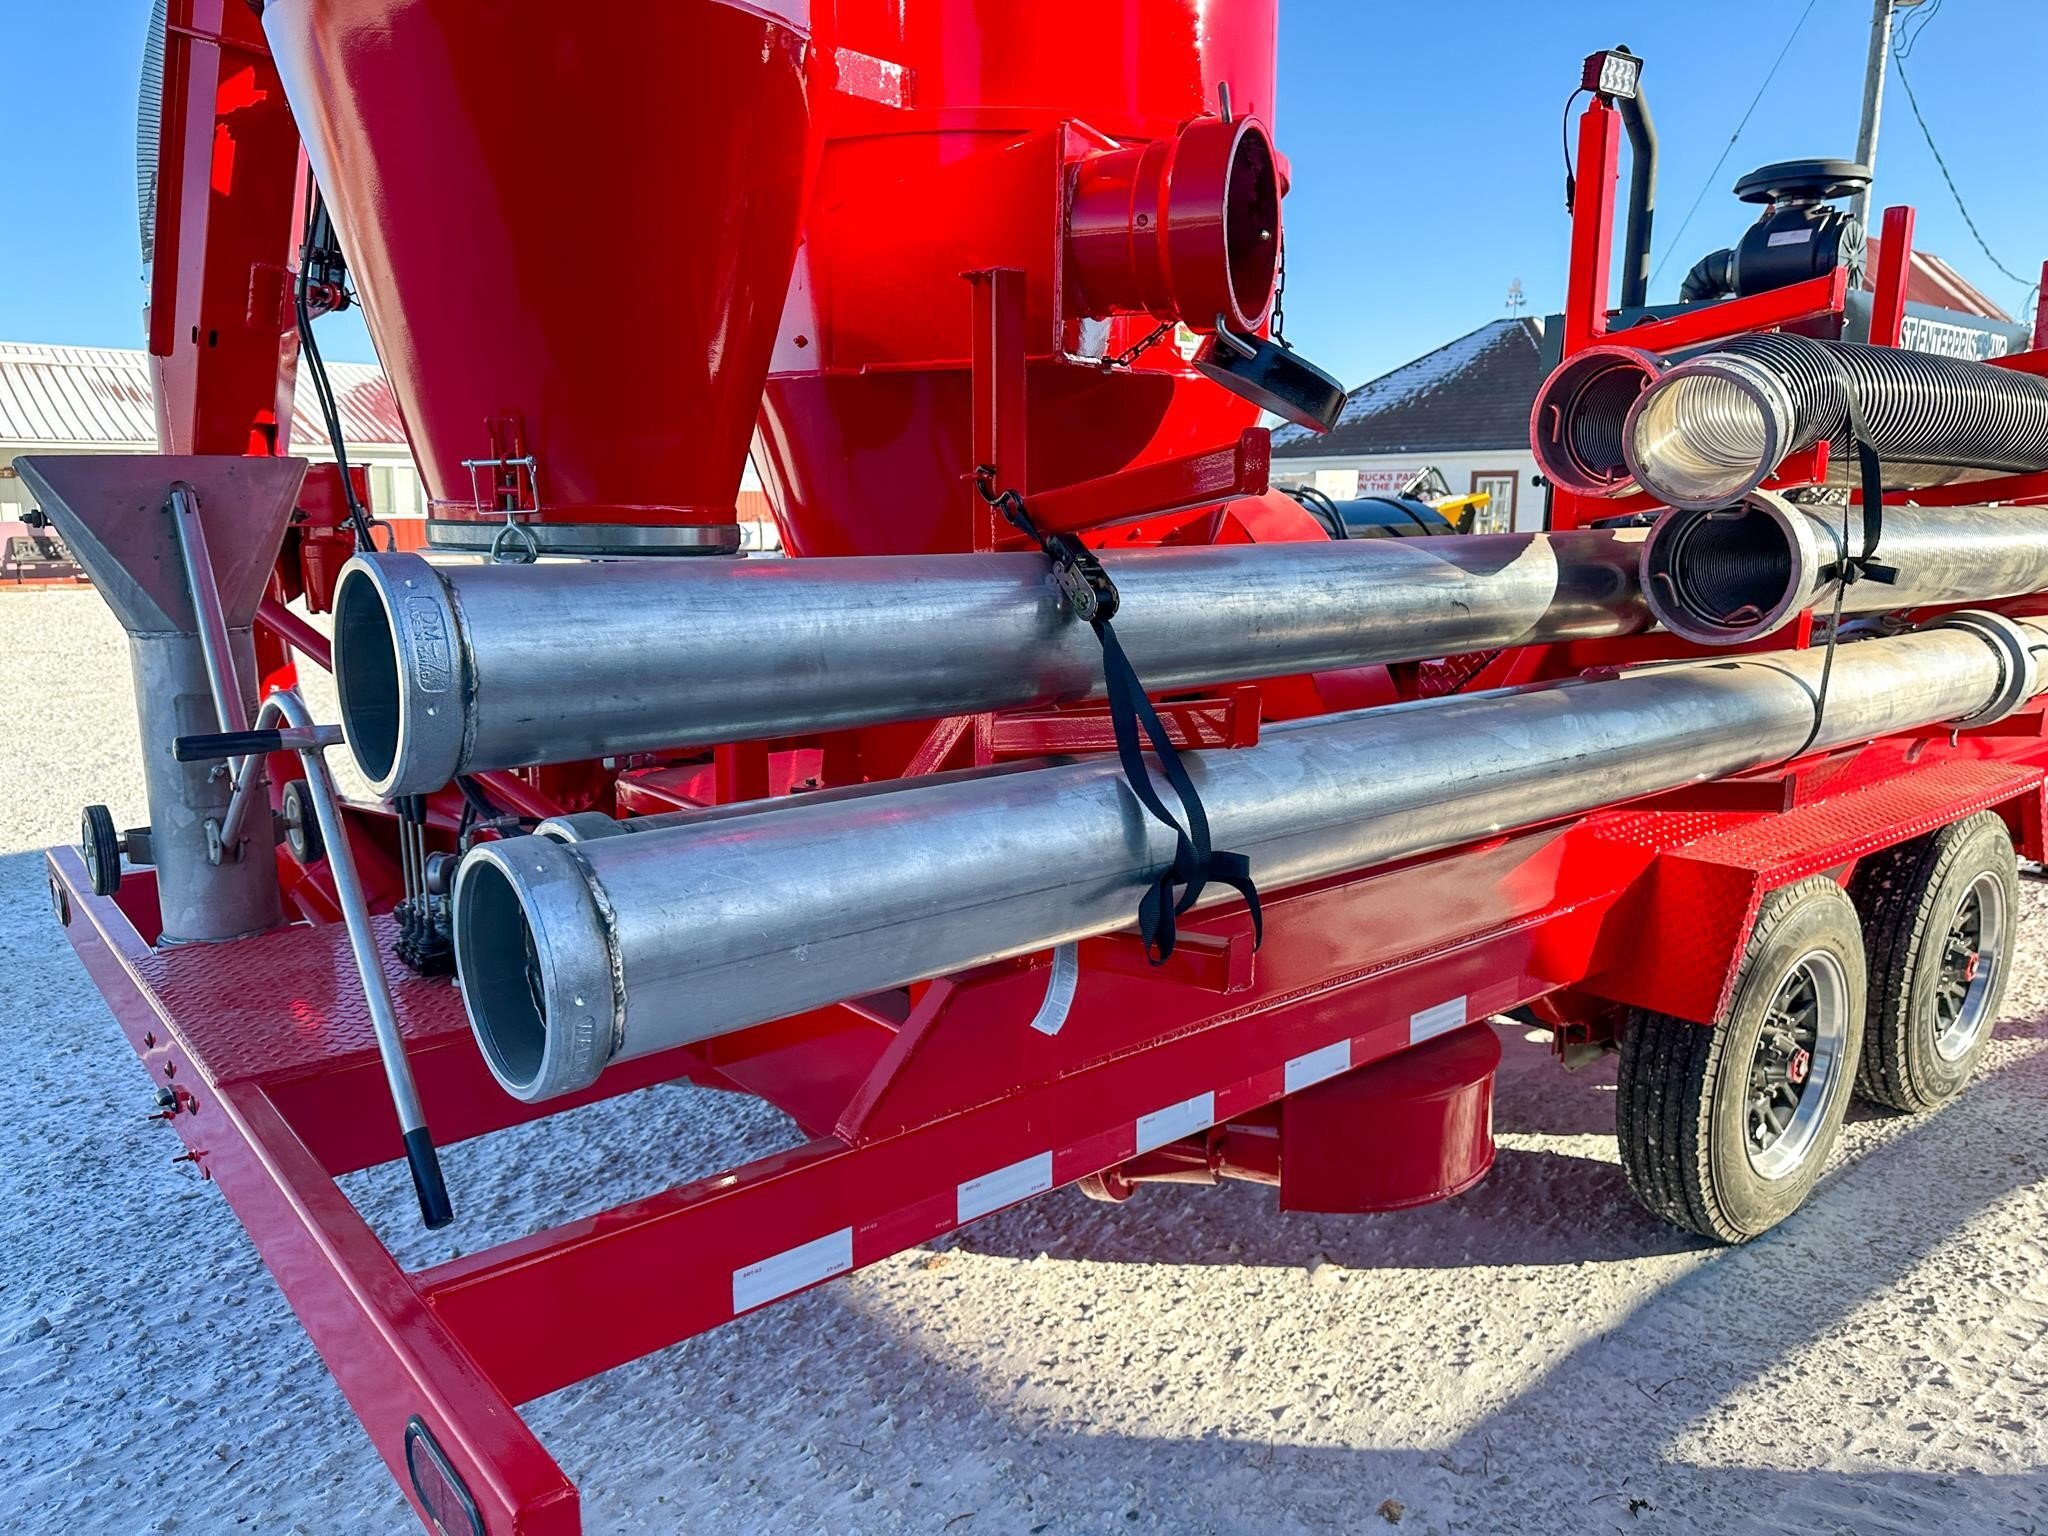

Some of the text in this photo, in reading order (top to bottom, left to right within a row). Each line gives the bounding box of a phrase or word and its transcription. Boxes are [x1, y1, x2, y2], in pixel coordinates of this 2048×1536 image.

[1918, 319, 1990, 361] ENTERPRIS
[1359, 473, 1393, 481] RUCKS
[1371, 483, 1390, 491] THE
